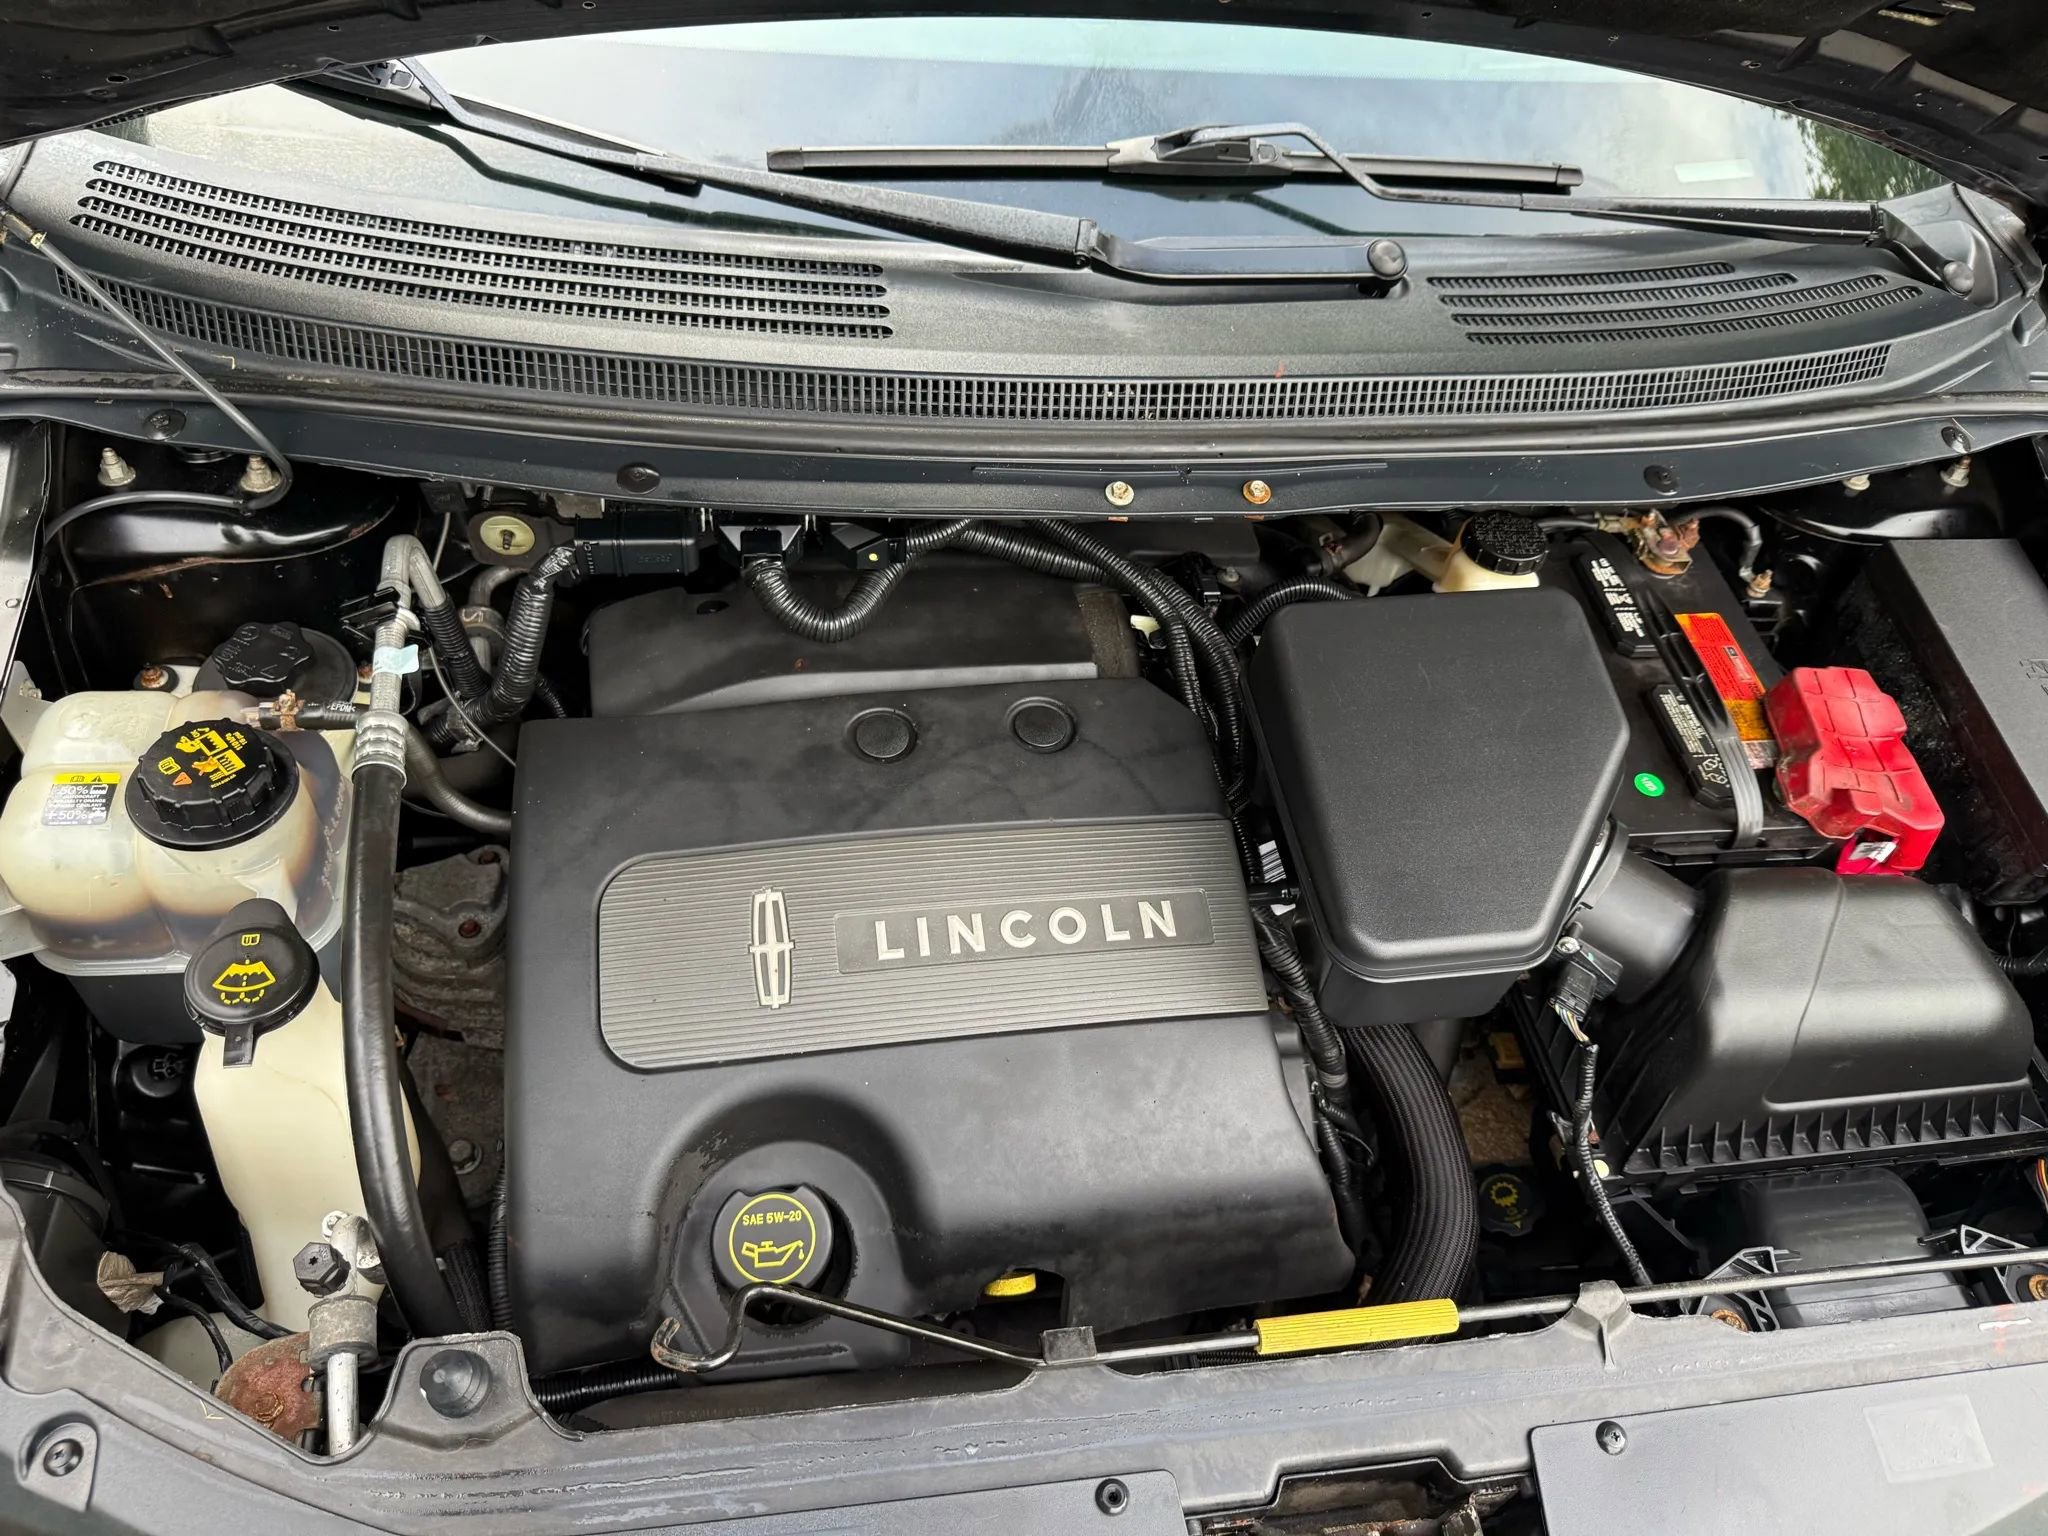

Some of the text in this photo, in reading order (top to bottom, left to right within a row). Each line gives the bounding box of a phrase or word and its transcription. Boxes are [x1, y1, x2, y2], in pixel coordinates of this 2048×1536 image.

[875, 900, 1177, 960] LINCOLN
[742, 1210, 802, 1226] SAE 5W-20
